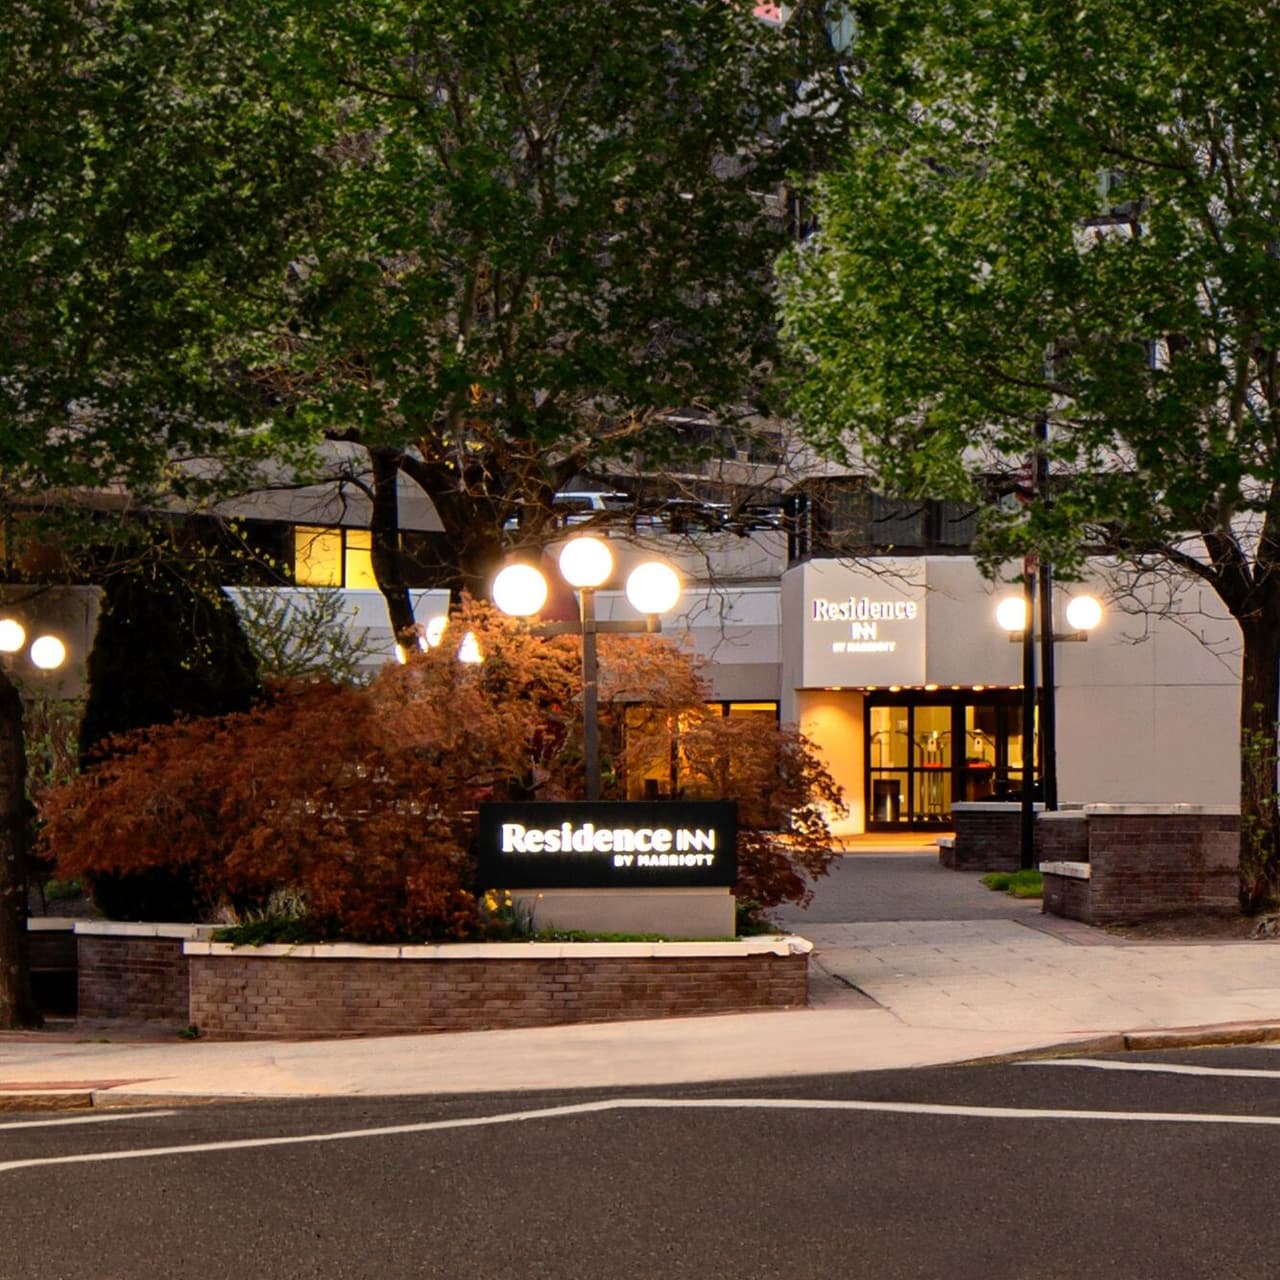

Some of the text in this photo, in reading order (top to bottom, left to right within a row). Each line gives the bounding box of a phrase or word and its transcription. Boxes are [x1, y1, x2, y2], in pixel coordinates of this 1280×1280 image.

[812, 596, 918, 621] Residence
[501, 821, 716, 853] Residence INN
[613, 854, 715, 867] BY MARRIOTT
